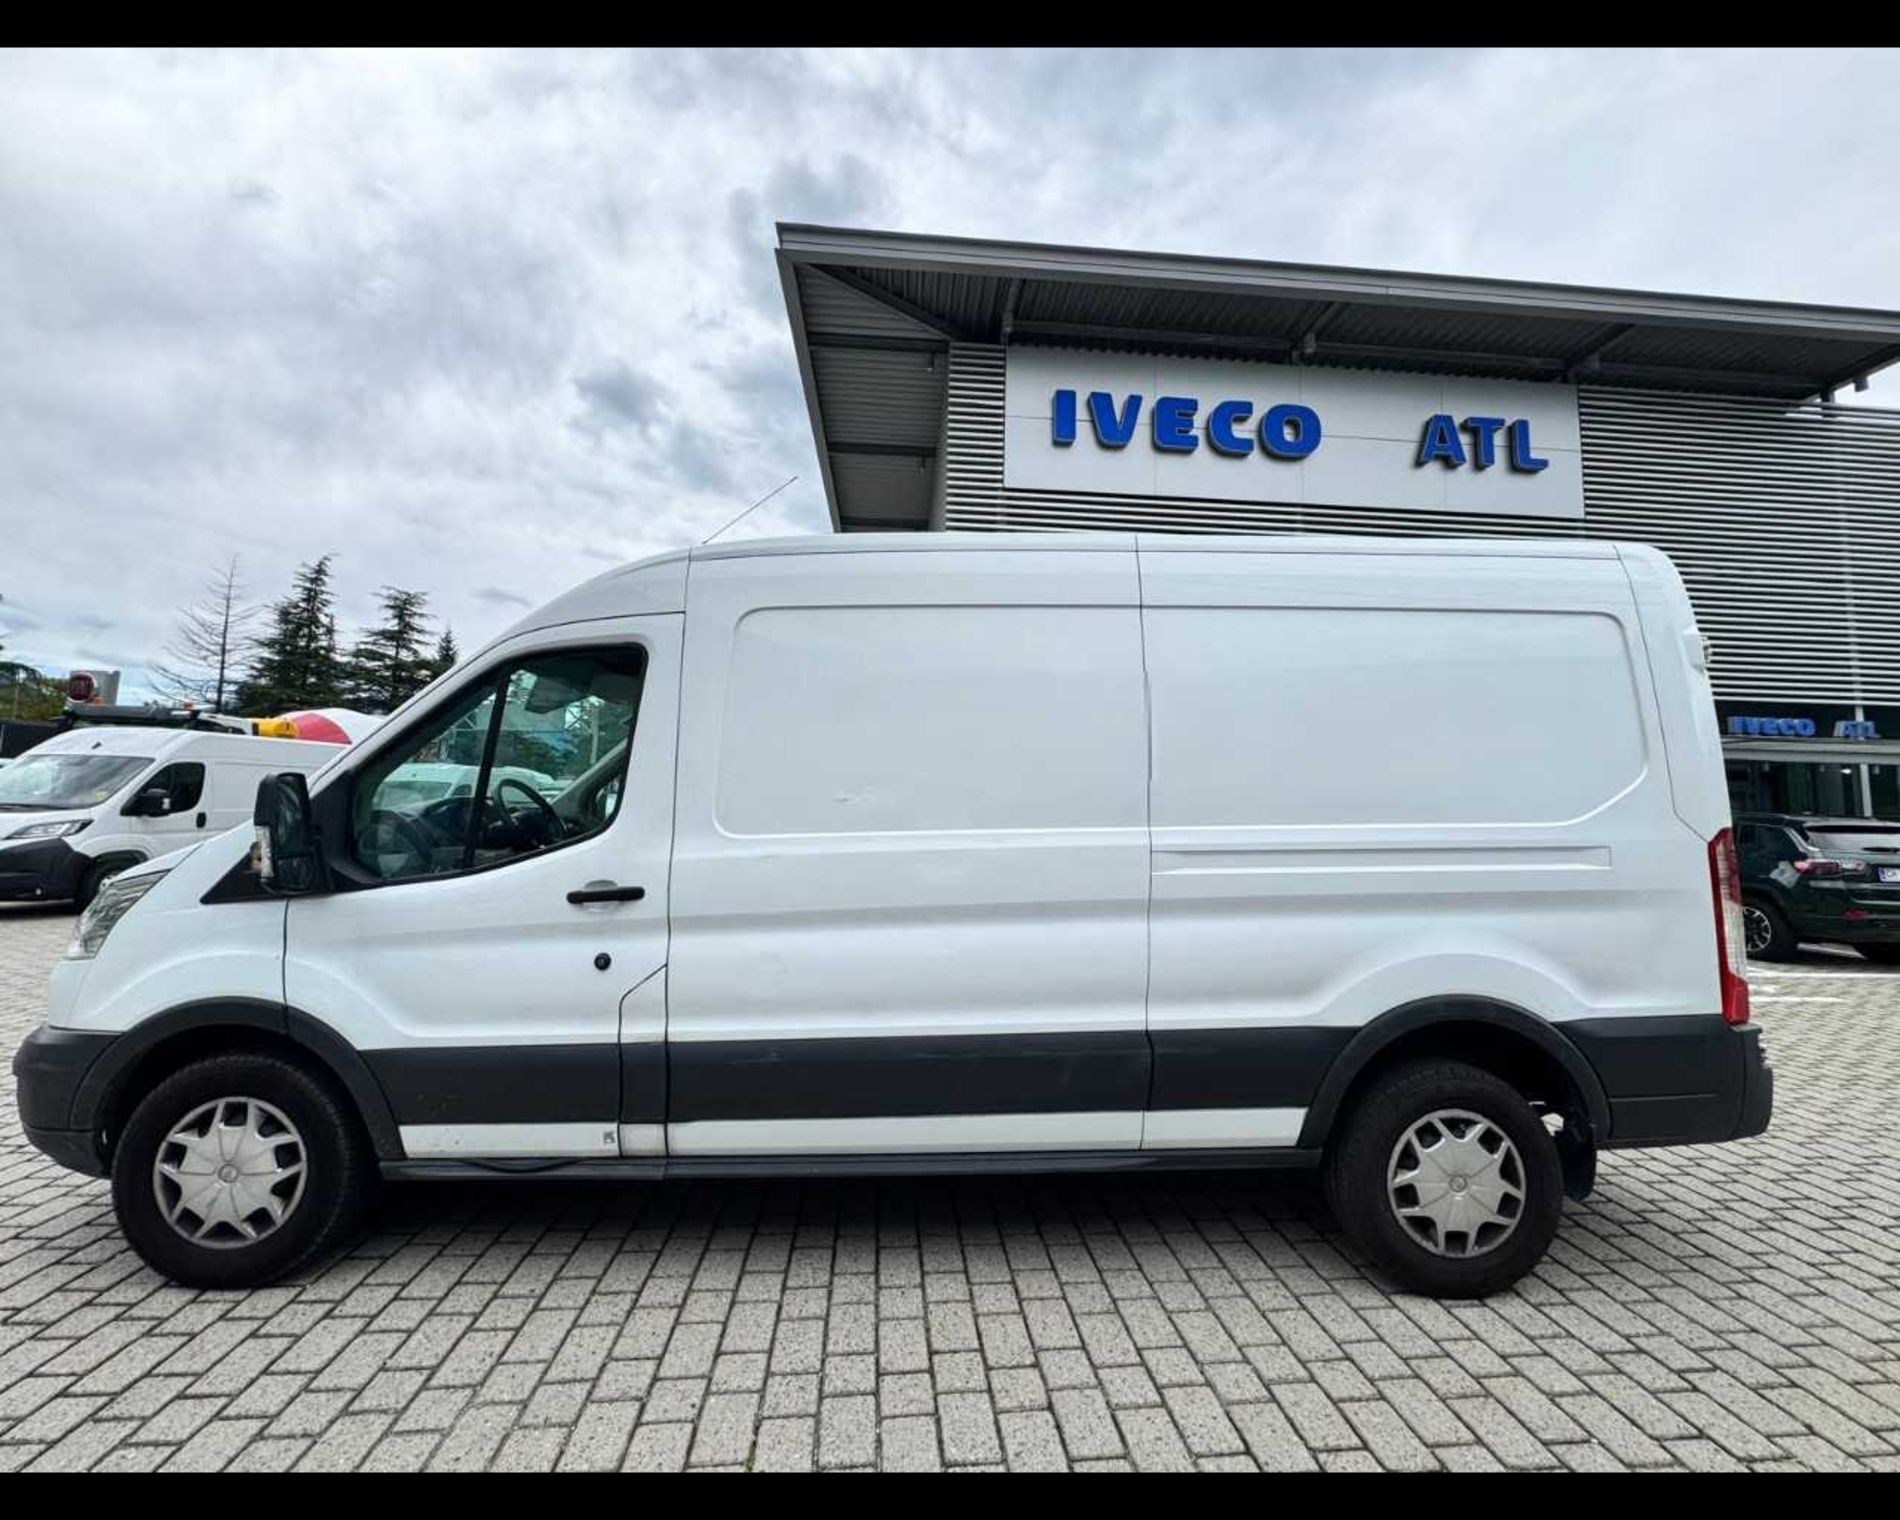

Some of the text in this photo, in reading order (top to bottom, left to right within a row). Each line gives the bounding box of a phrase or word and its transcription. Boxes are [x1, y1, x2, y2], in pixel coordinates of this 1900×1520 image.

[1051, 389, 1548, 471] IVECO ATL
[1729, 716, 1816, 736] IVECO
